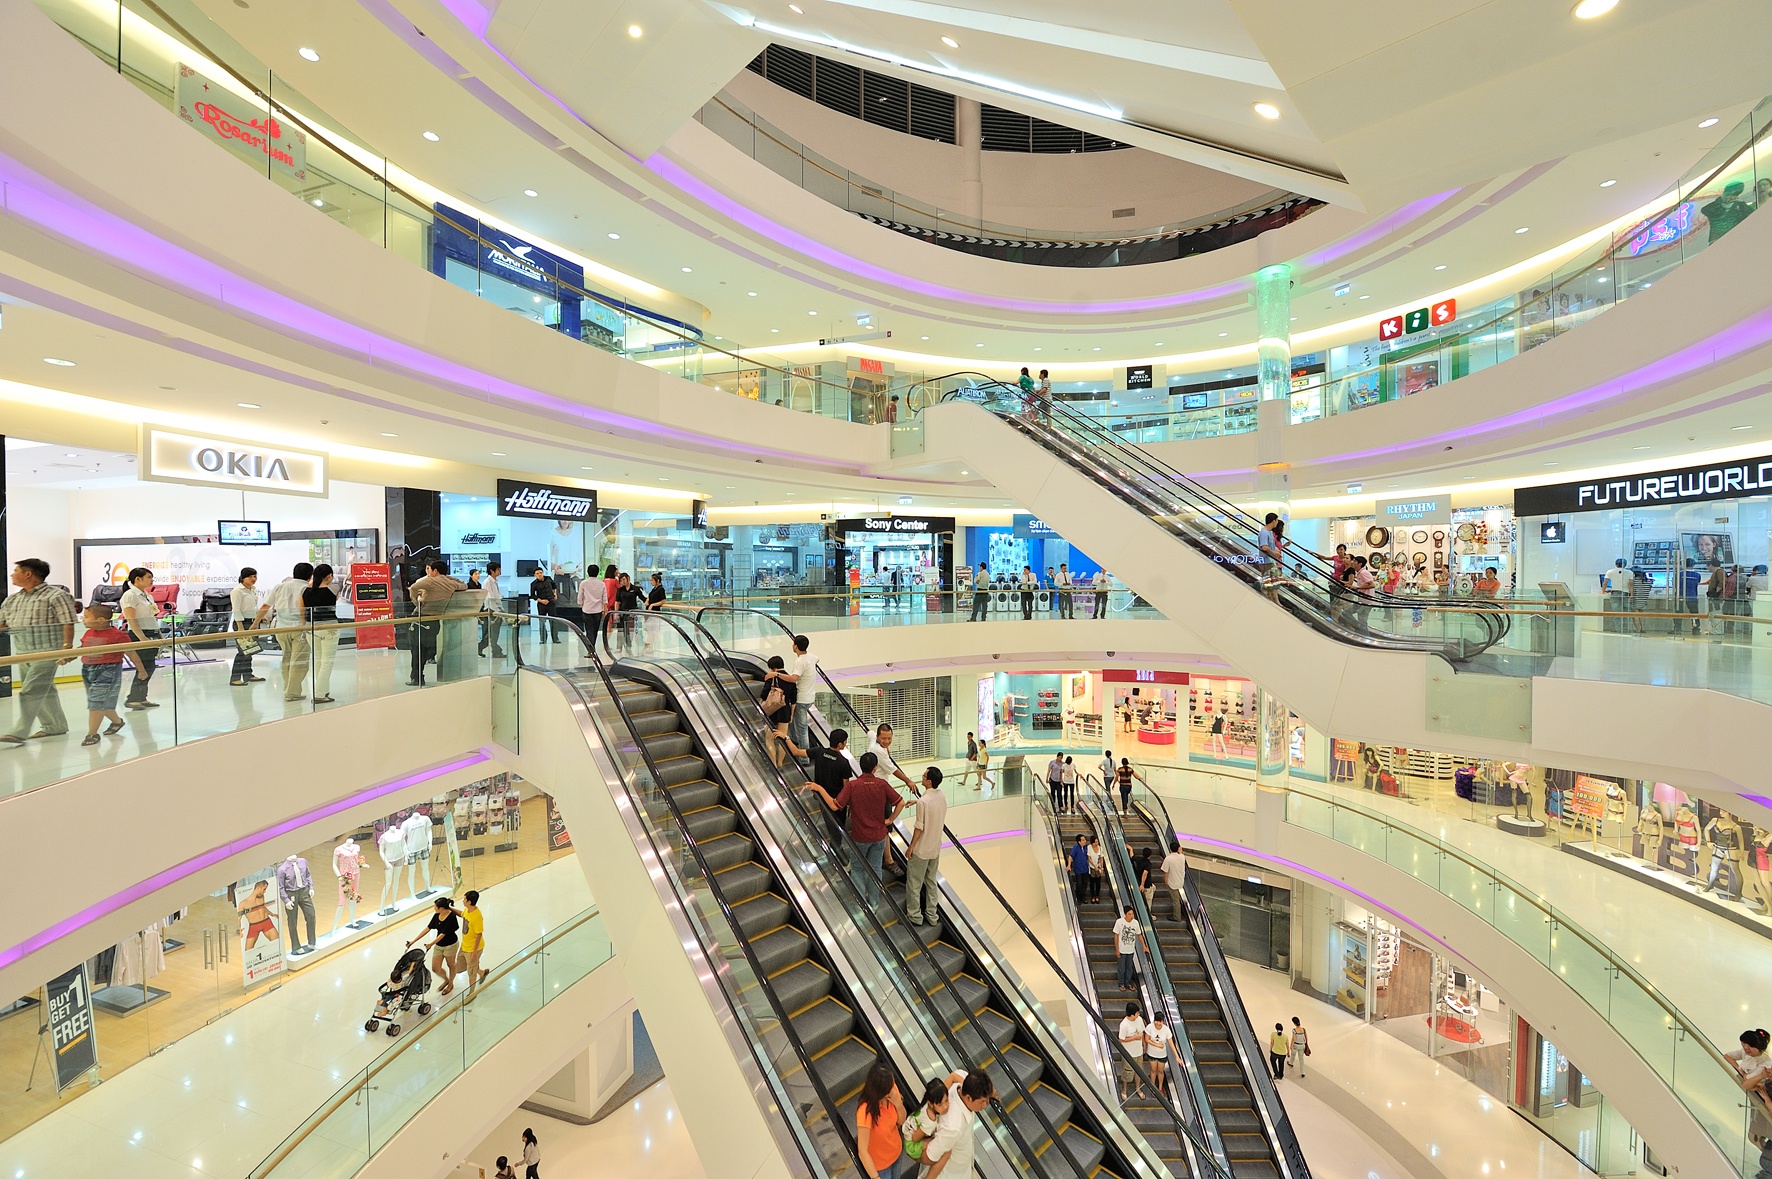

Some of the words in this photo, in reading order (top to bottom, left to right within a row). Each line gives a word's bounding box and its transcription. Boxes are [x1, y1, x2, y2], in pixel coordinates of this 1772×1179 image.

[194, 101, 294, 167] Rosarium
[197, 448, 289, 480] OKIA
[1386, 502, 1437, 515] RHYTHM
[1397, 512, 1423, 520] JAPAN
[865, 518, 891, 531] Sony
[894, 519, 928, 531] Center
[170, 561, 193, 570] healthy
[195, 561, 211, 570] living
[171, 575, 205, 583] ENJOYABLE
[206, 575, 239, 585] experienc
[182, 589, 204, 598] Suppor
[49, 989, 71, 1012] BUY
[69, 973, 85, 1008] 1
[51, 1002, 71, 1024] GET
[53, 1008, 90, 1050] FREE
